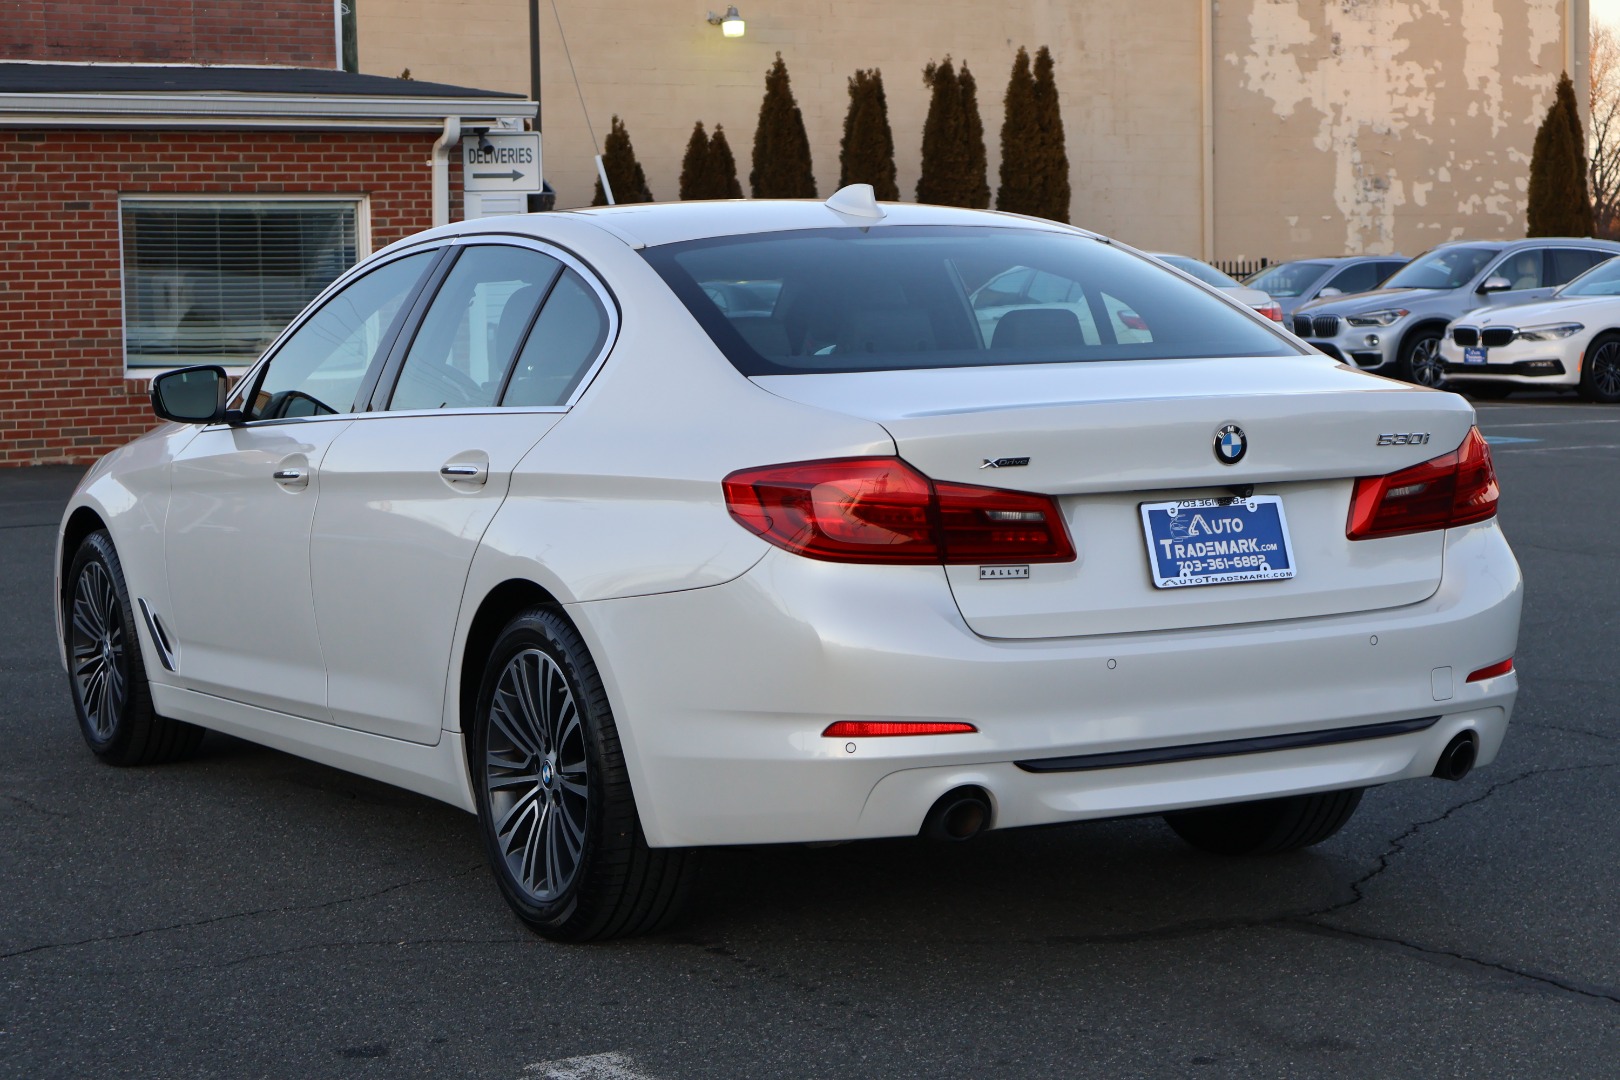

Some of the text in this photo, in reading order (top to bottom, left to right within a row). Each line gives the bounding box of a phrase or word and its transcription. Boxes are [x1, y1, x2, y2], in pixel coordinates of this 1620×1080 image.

[468, 147, 533, 164] DELIVERIES
[1217, 425, 1245, 439] BMW
[1376, 432, 1421, 446] 530i
[1176, 554, 1266, 573] 703-361-6882
[981, 568, 1028, 577] RALLYE
